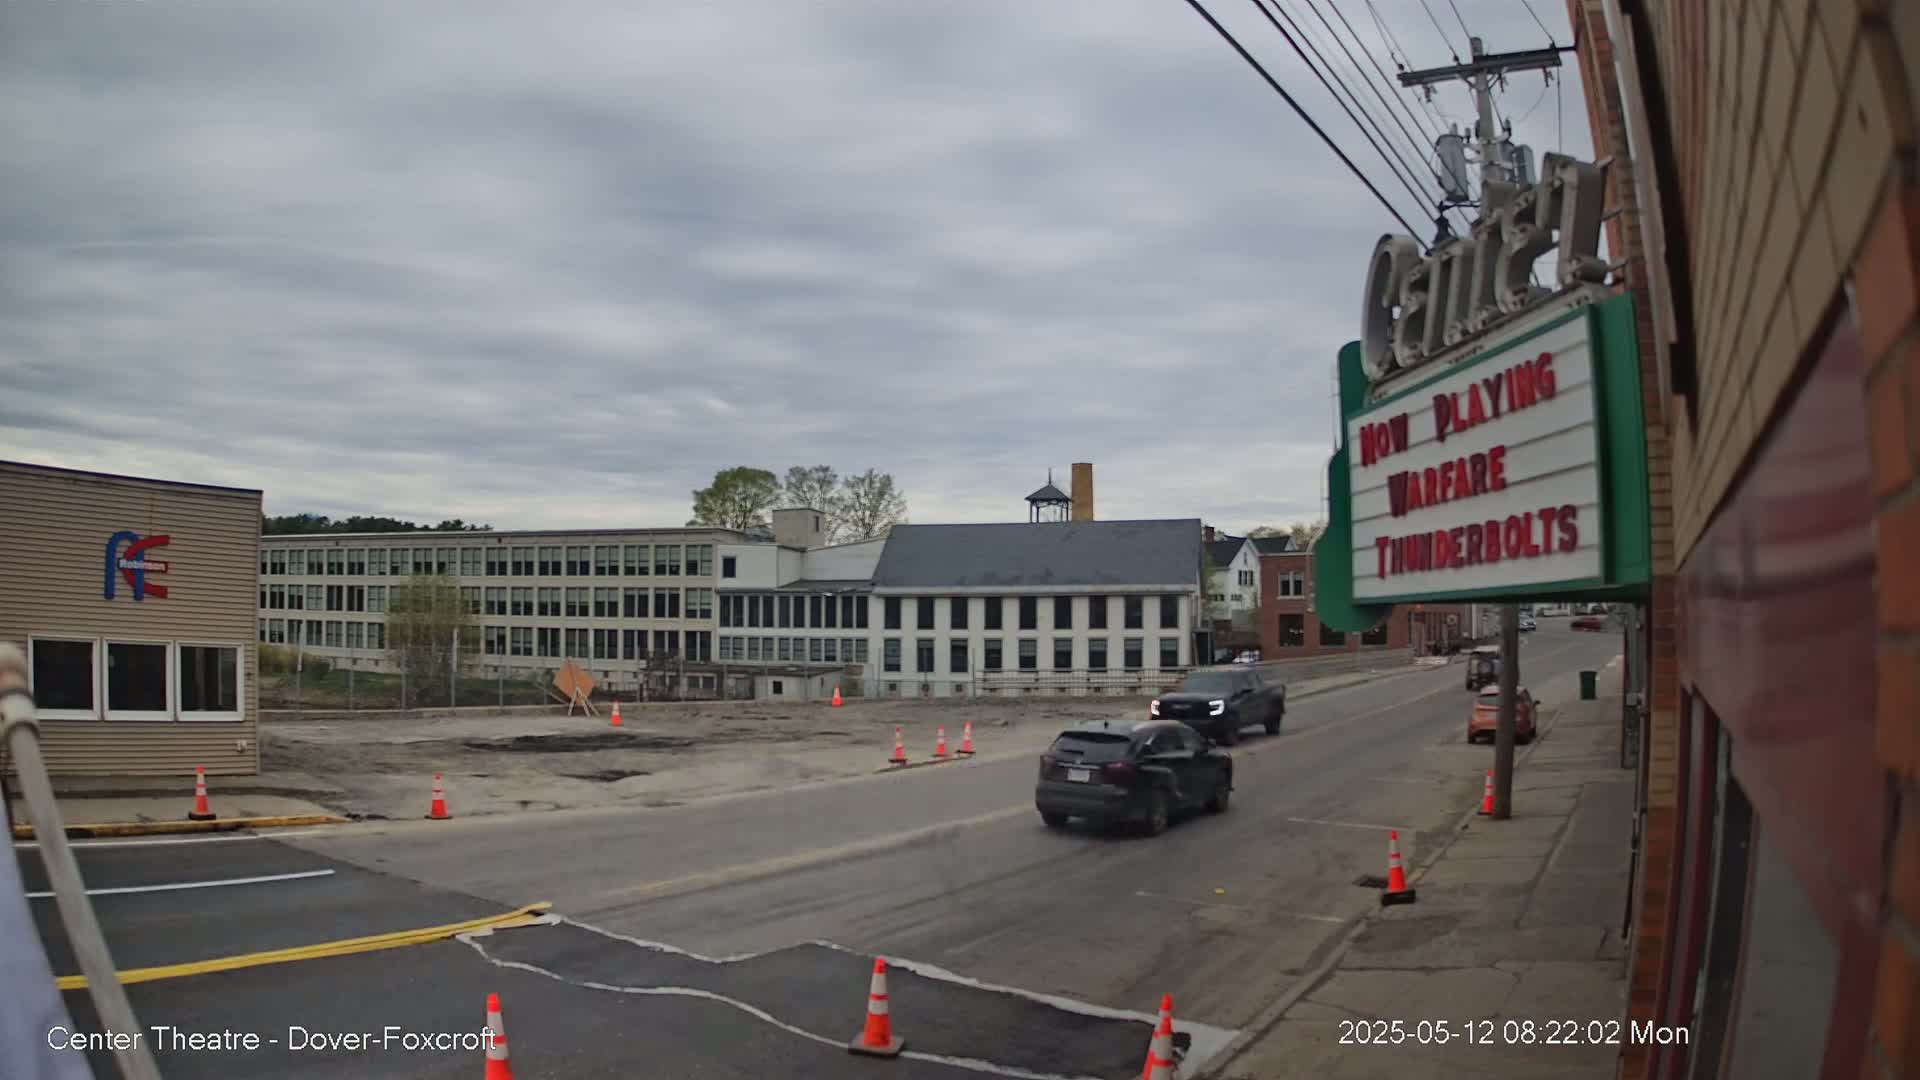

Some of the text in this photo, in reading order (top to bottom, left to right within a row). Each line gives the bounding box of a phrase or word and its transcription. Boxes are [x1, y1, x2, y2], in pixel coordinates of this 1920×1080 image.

[1359, 352, 1557, 467] NOW PLAYING
[1387, 445, 1506, 518] WARFARE
[119, 559, 166, 572] Robinson
[1375, 504, 1579, 579] THUNDERBOLTS
